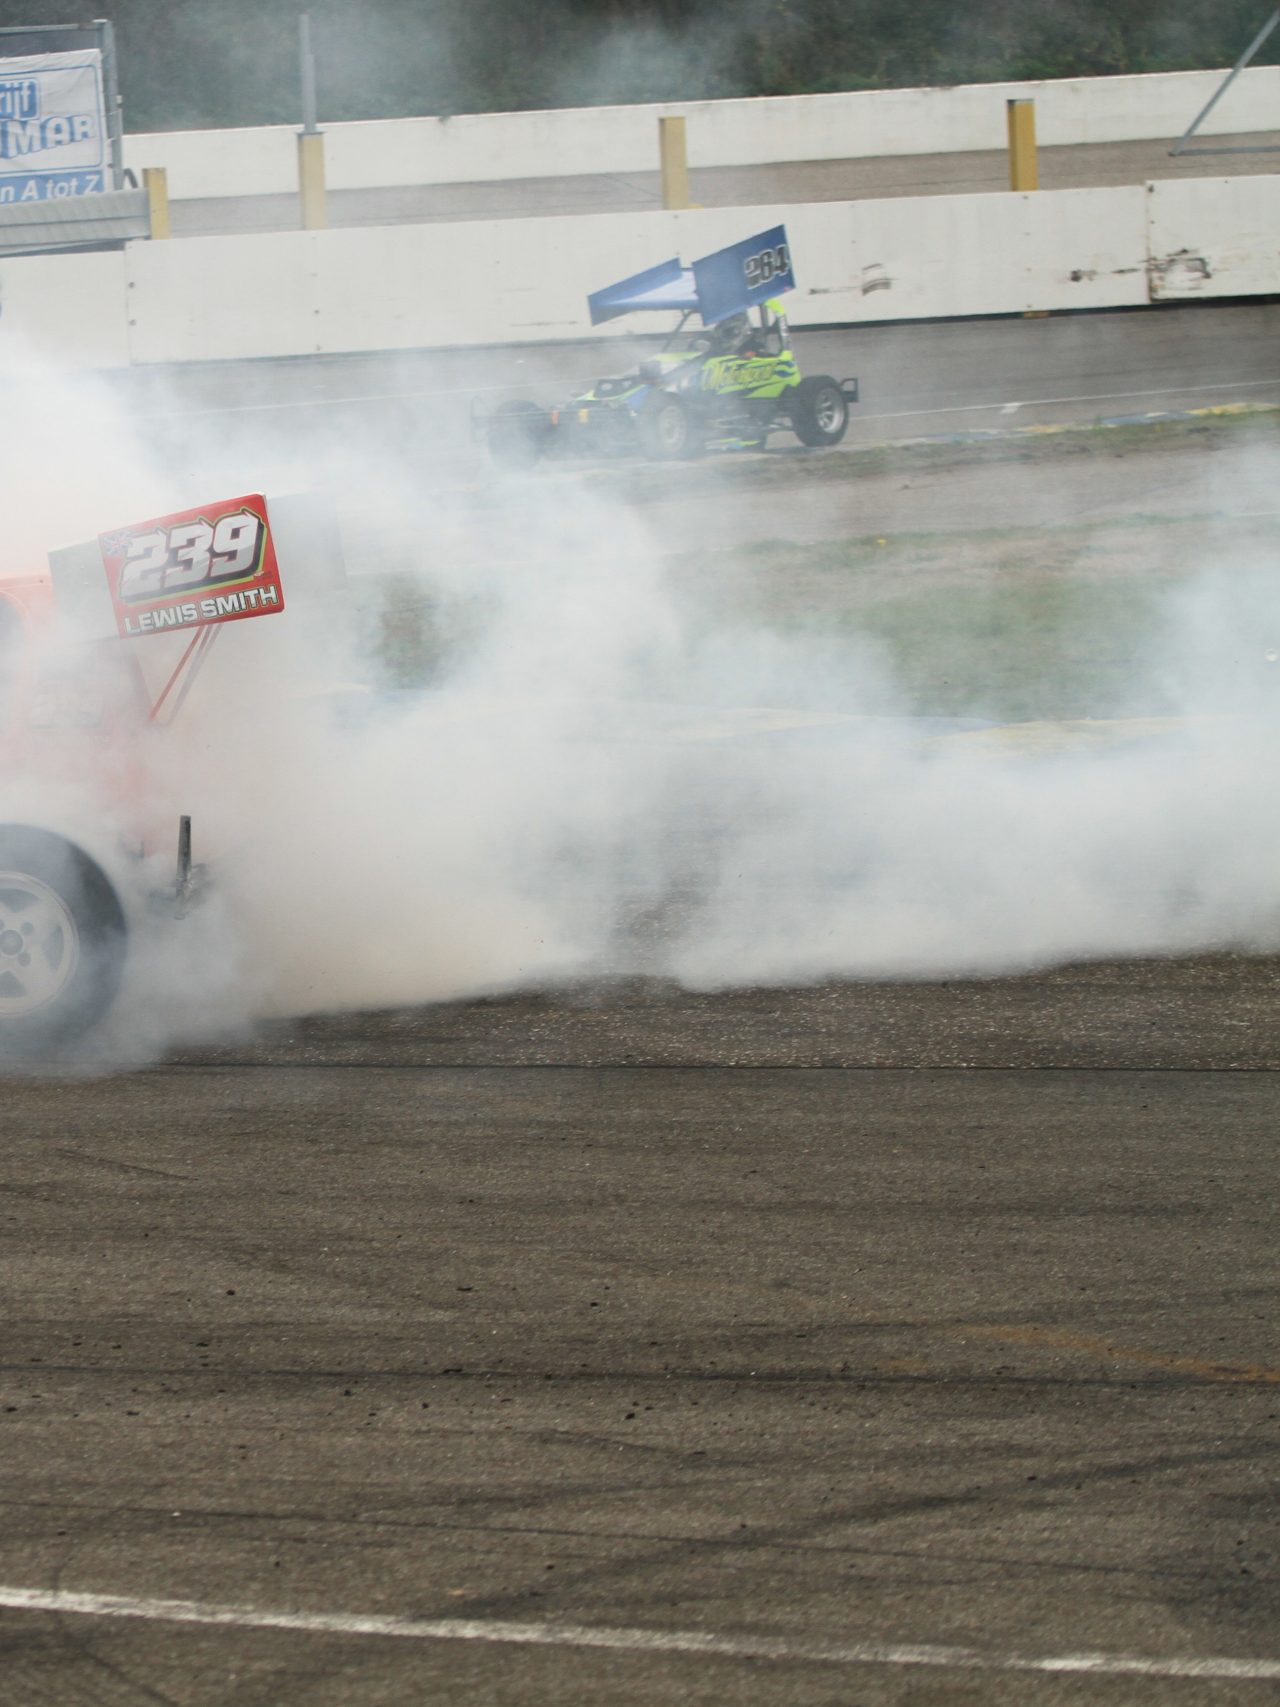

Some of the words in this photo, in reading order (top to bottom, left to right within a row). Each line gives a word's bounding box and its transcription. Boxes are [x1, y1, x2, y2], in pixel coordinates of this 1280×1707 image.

[21, 179, 39, 201] A
[43, 177, 79, 198] tot
[83, 174, 101, 195] Z
[122, 510, 261, 592] 239
[124, 603, 198, 634] LEWIS
[202, 584, 278, 619] SMITH
